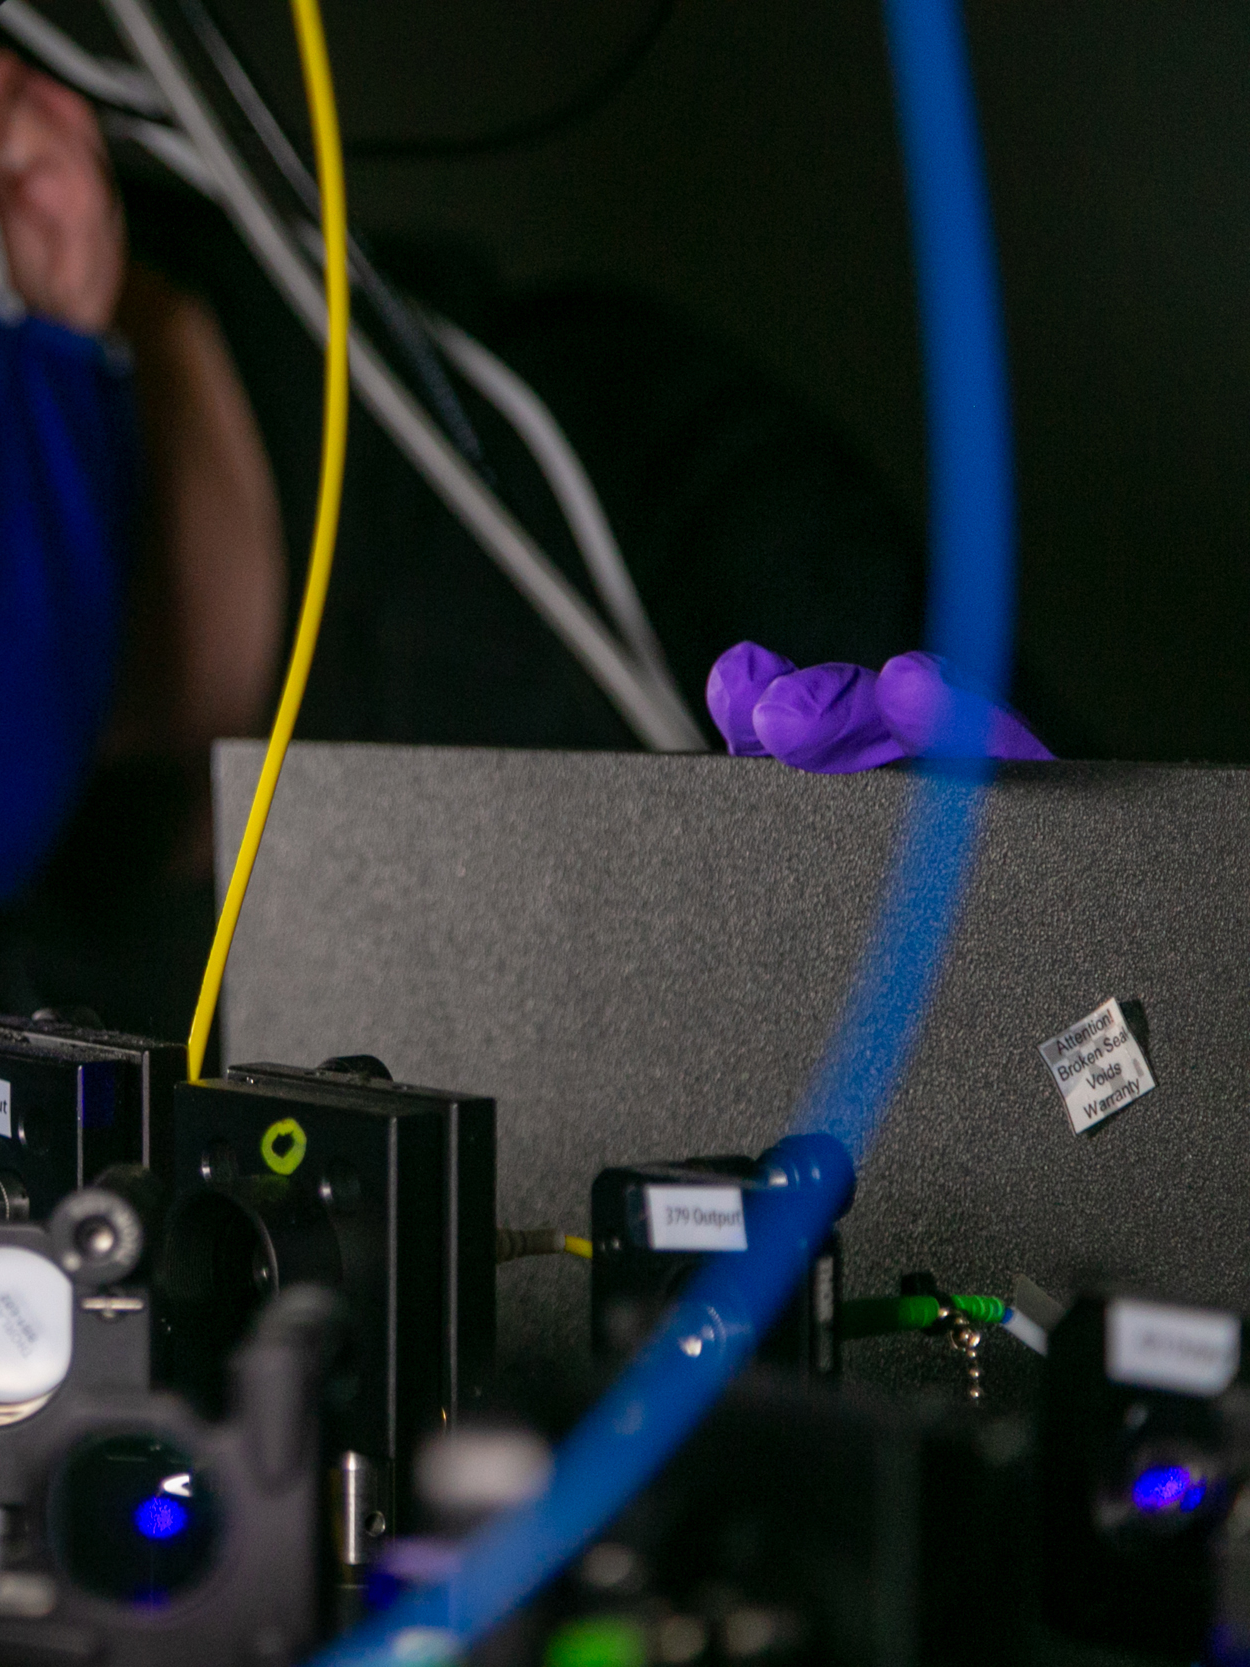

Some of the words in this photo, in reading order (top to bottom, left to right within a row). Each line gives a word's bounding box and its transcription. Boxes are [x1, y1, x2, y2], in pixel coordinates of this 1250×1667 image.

[1056, 1008, 1115, 1055] Attention!
[1057, 1048, 1104, 1082] Broken
[1103, 1026, 1130, 1053] Seal
[1086, 1061, 1123, 1090] Voids
[1083, 1078, 1141, 1119] Warranty
[666, 1205, 690, 1227] 379
[693, 1206, 742, 1231] Output
